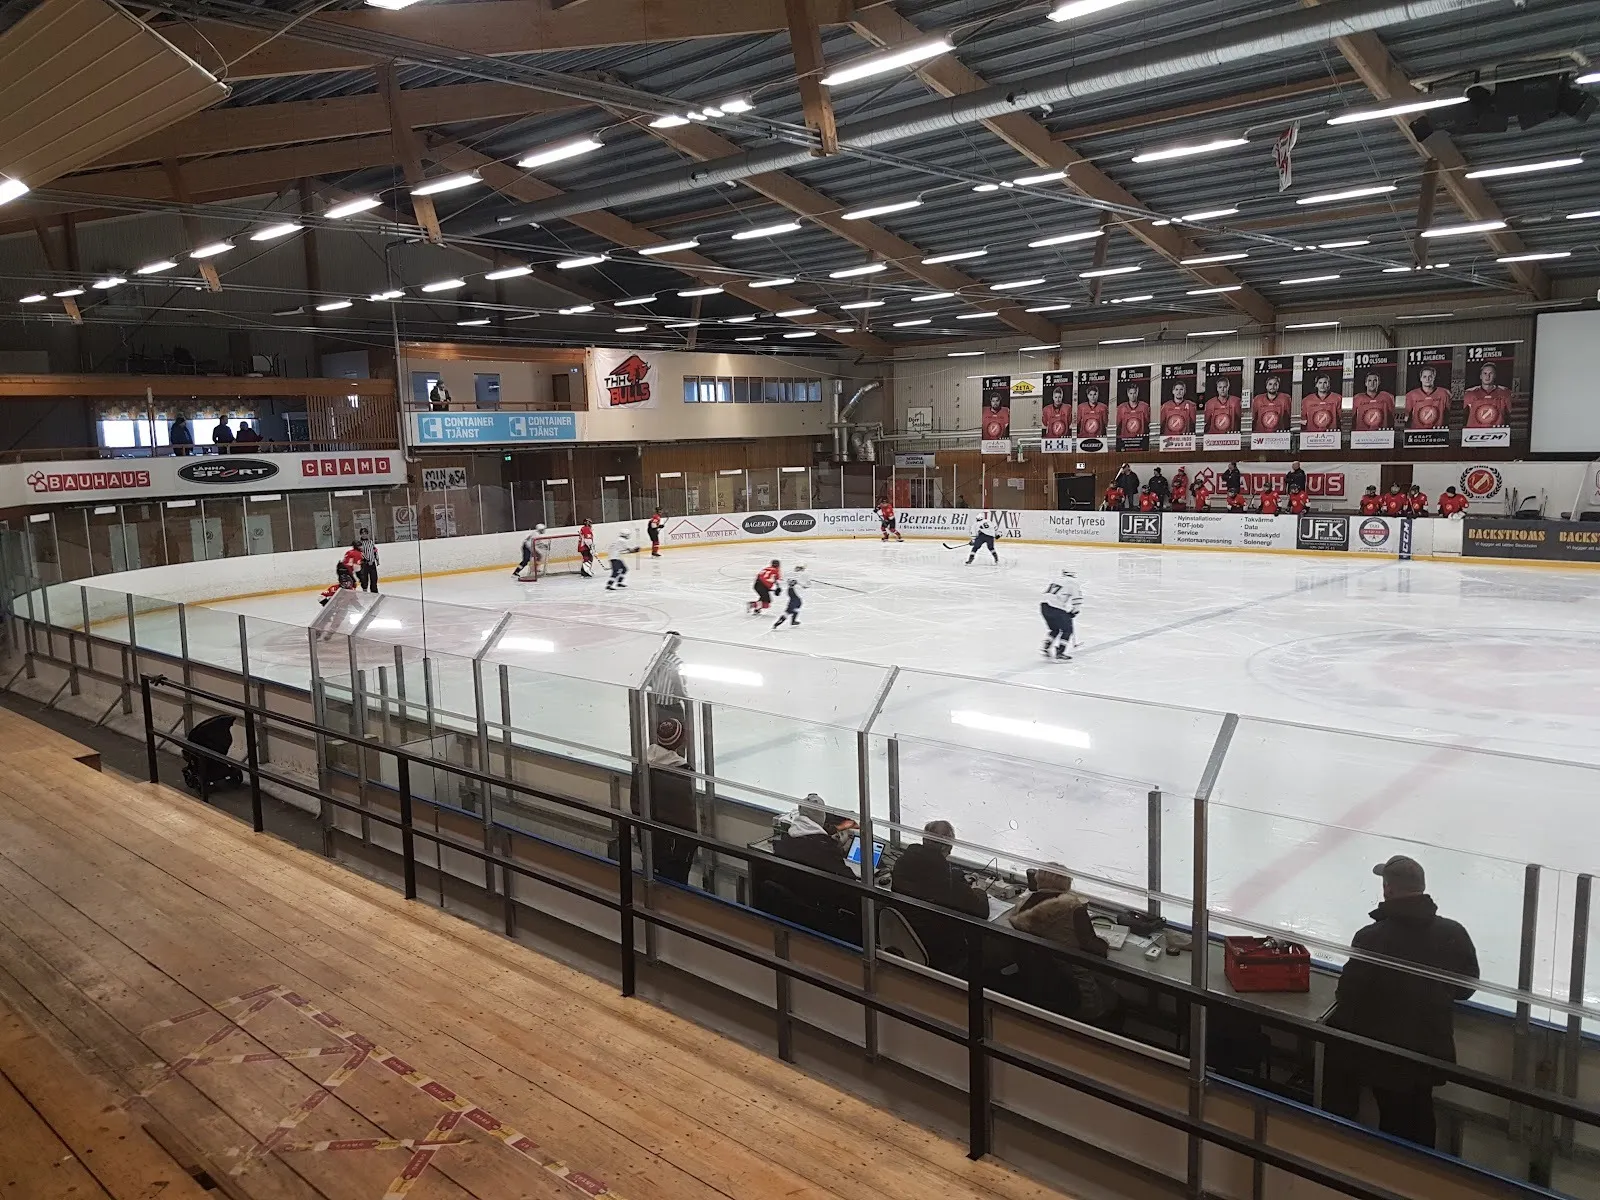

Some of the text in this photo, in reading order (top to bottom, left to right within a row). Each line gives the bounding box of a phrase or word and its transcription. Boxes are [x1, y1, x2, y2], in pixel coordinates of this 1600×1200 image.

[1409, 351, 1422, 362] 11
[1469, 347, 1483, 358] 12
[1306, 357, 1314, 368] 9
[1356, 354, 1369, 365] 10
[1209, 363, 1216, 373] 6
[1258, 360, 1265, 370] 7
[1120, 370, 1127, 379] 4
[1165, 366, 1172, 376] 5
[604, 375, 626, 388] THH
[1045, 375, 1051, 384] 2
[1081, 372, 1087, 382] 3
[985, 380, 990, 388] 1
[608, 382, 651, 406] BULLS
[444, 417, 495, 427] CONTAINER
[528, 416, 572, 425] CONTAINER
[445, 428, 480, 438] TJÄNST
[529, 427, 559, 436] TJÄNST
[304, 459, 389, 474] CRAMO
[193, 468, 268, 477] SPORT
[425, 469, 446, 480] MIN
[48, 472, 150, 491] BAUHAUS
[1218, 475, 1342, 492] BAUHUS
[899, 512, 969, 525] Bernats Bil
[1049, 515, 1106, 527] Notar Tyresö
[744, 520, 776, 528] BAGERIET
[1123, 515, 1158, 534] JFK
[706, 530, 738, 538] MONTERA
[1006, 530, 1022, 538] AB
[1302, 519, 1344, 540] JFK
[671, 531, 701, 540] MONTERA
[1402, 522, 1410, 553] CCM
[1177, 537, 1233, 545] Kontorsanpassning
[1045, 583, 1063, 595] 17
